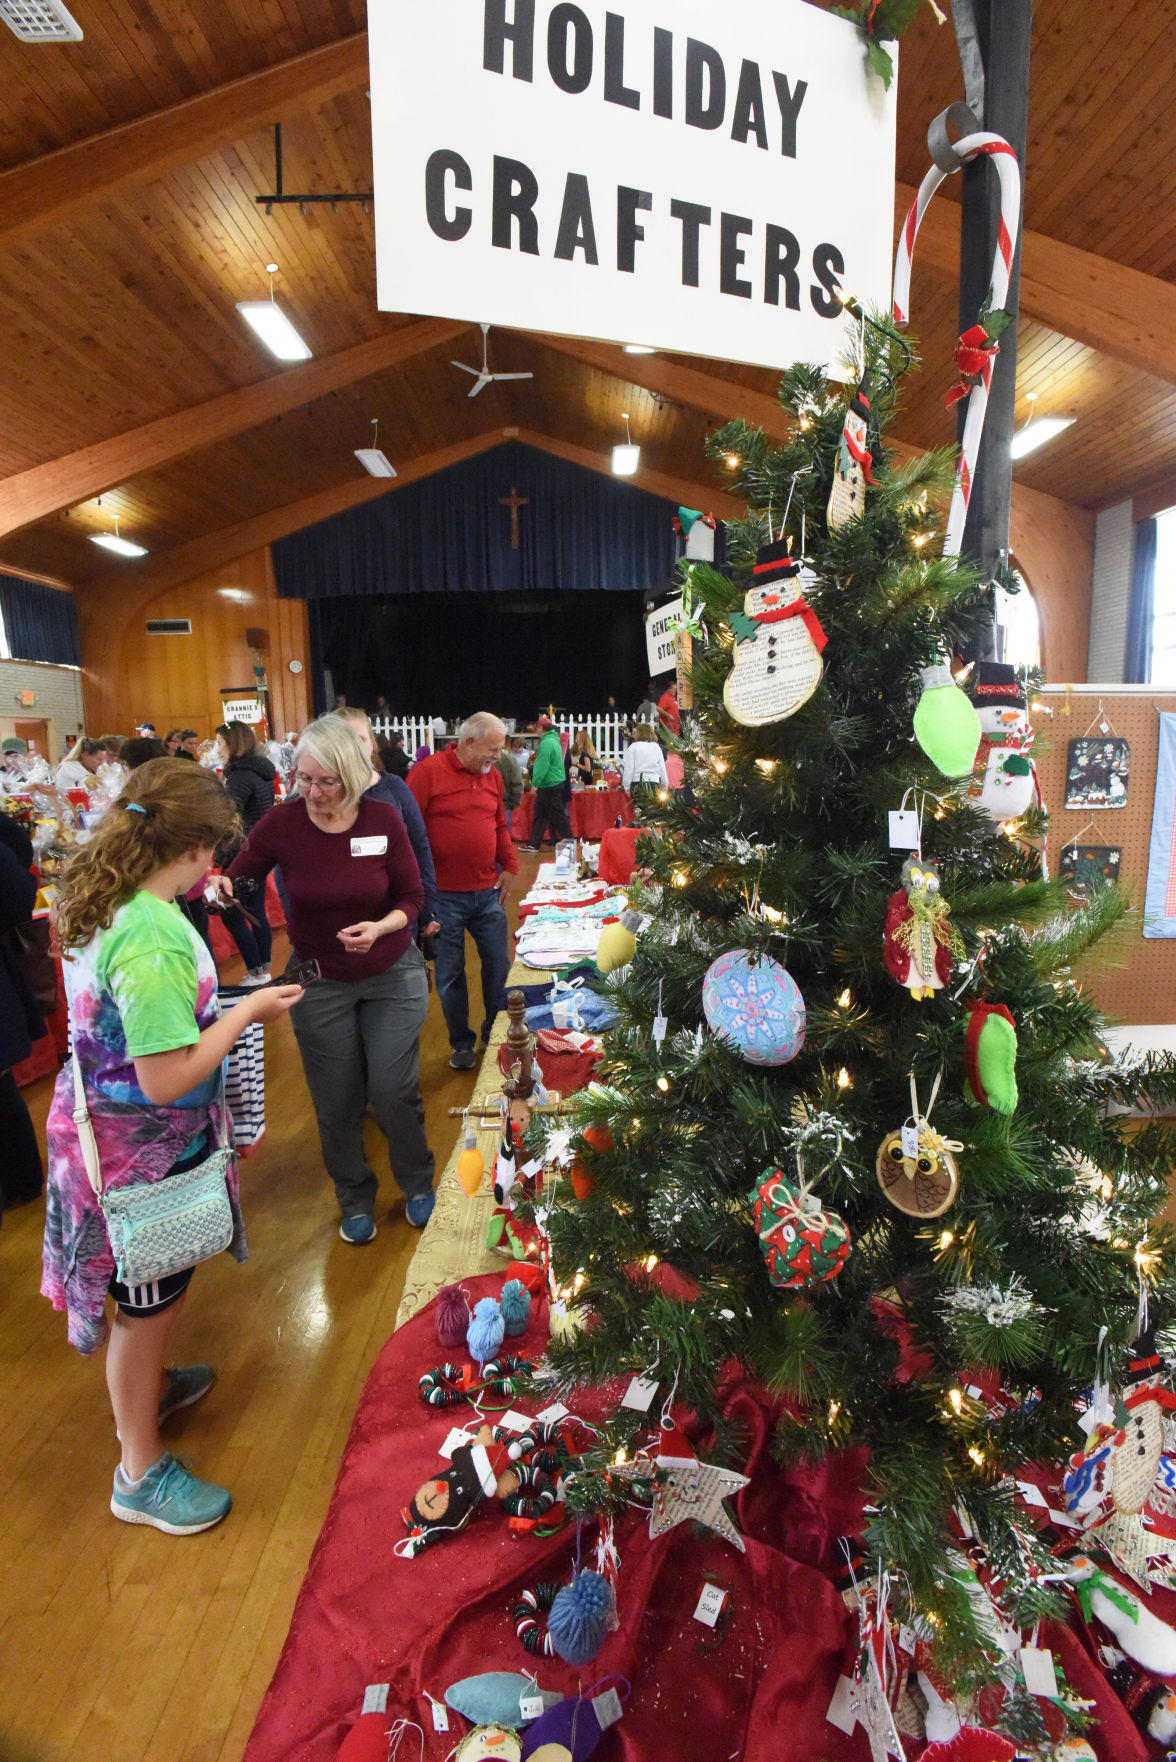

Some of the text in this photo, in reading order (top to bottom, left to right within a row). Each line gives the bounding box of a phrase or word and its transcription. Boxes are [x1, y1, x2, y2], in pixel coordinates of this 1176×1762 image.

[482, 0, 808, 160] HOLIDAY
[425, 148, 845, 319] CRAFTERS
[701, 1602, 717, 1615] Sled
[706, 1590, 720, 1601] Cat
